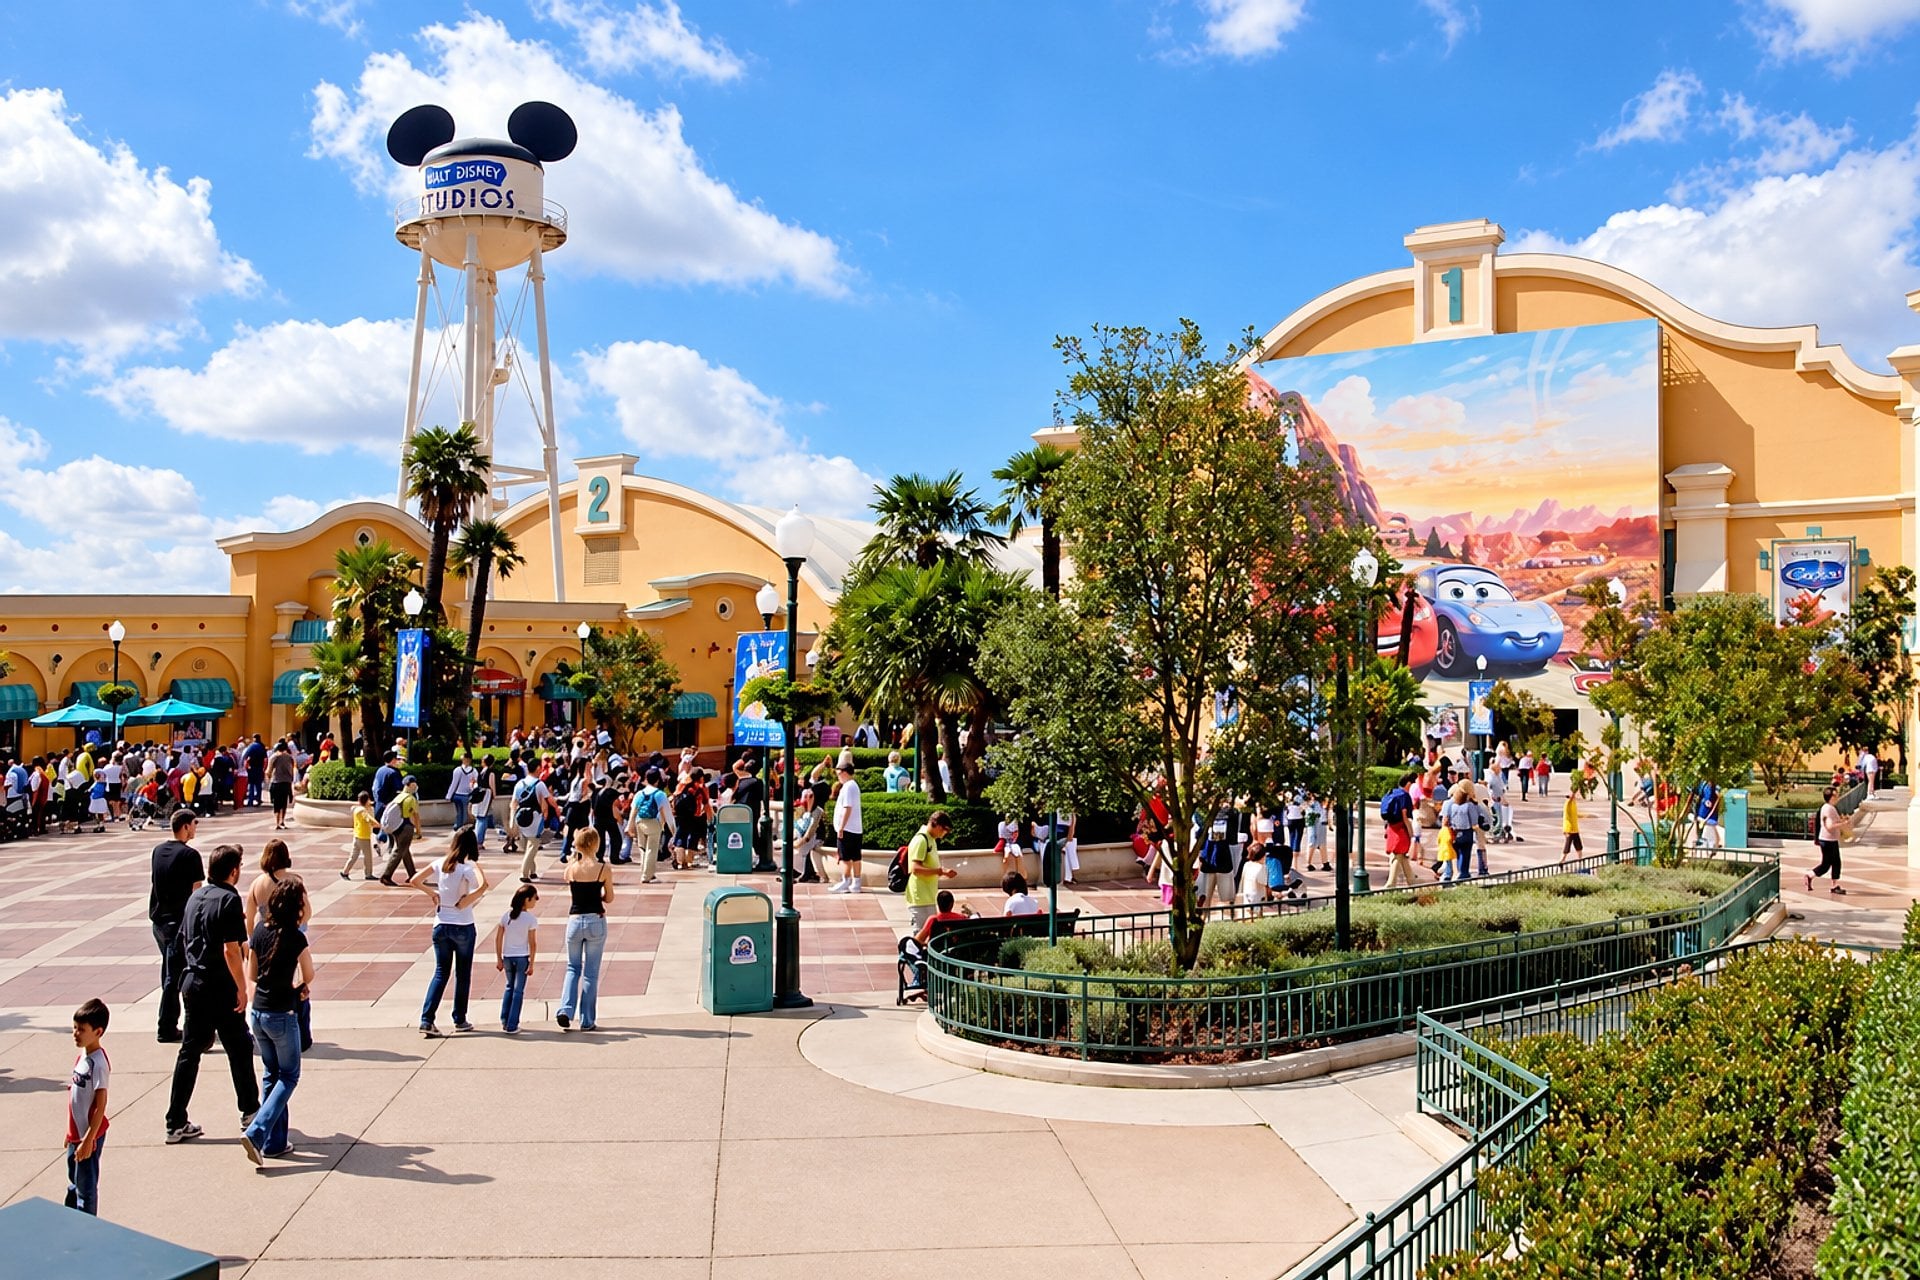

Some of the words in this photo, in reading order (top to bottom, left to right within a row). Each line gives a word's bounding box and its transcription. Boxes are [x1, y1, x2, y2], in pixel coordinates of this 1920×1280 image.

[456, 165, 501, 179] DISNEY
[421, 188, 514, 214] STUDIOS
[1442, 267, 1463, 322] 1
[588, 476, 610, 523] 2
